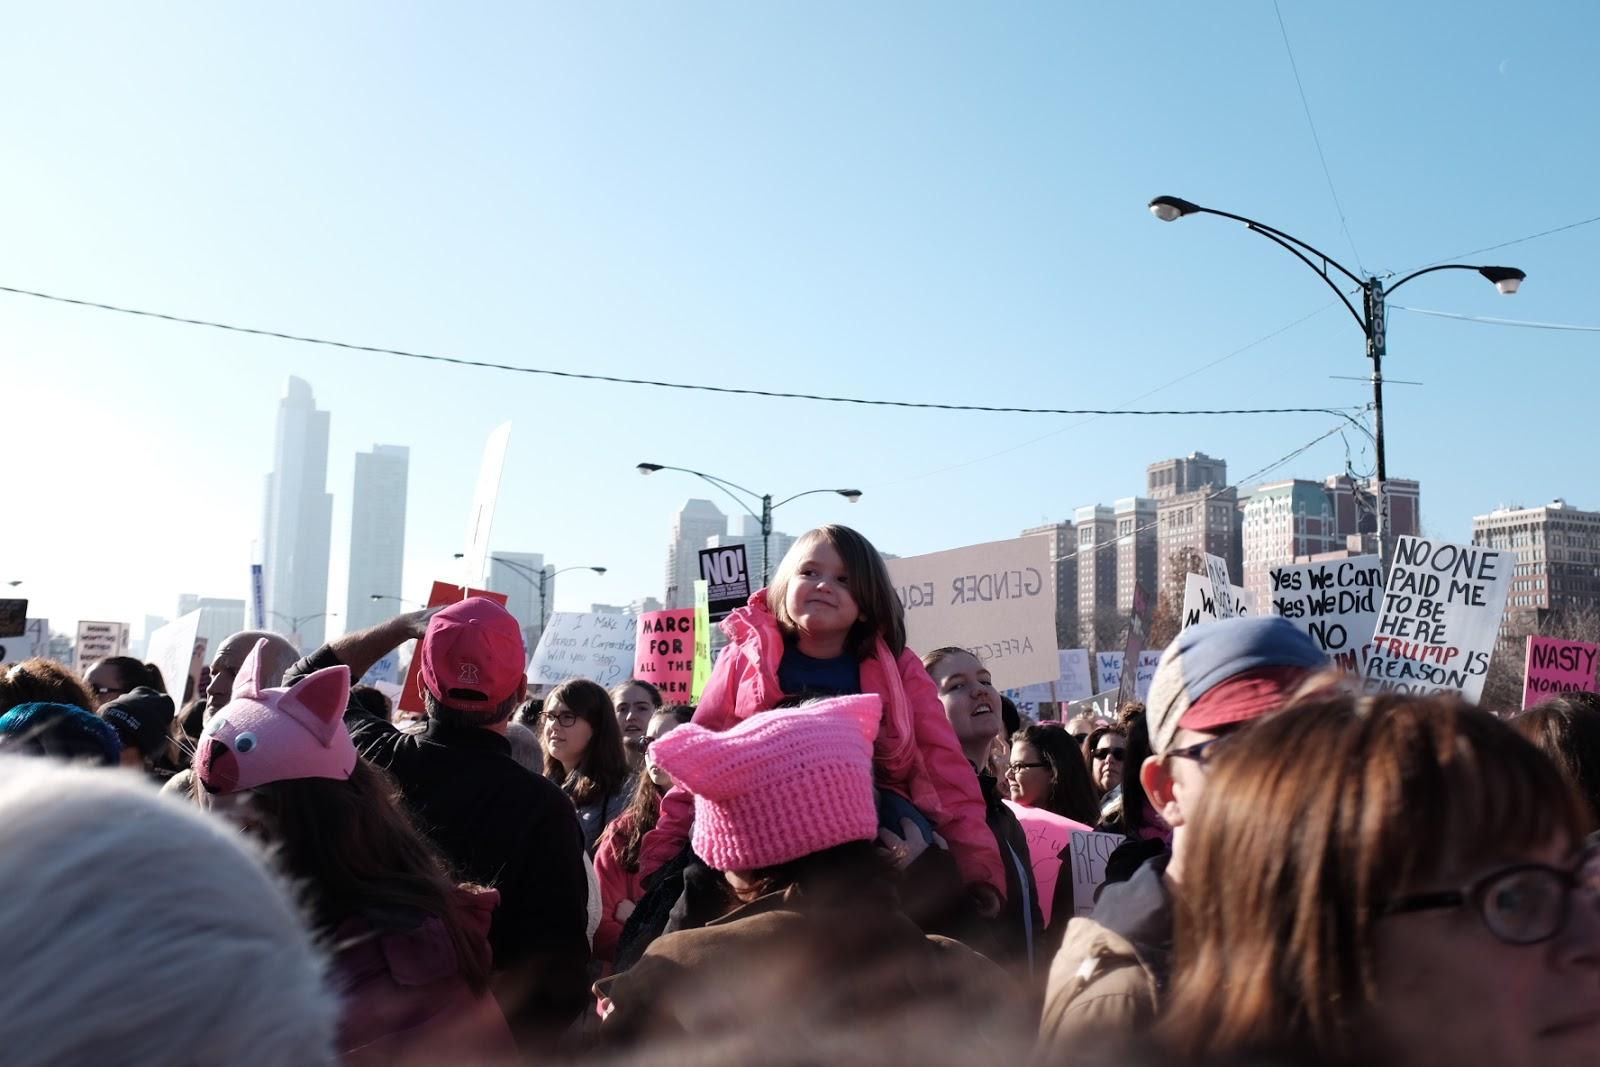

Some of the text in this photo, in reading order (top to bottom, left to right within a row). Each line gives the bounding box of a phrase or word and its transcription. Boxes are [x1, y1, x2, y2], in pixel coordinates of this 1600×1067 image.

[702, 549, 746, 586] NO!
[1396, 538, 1499, 581] NO ONE
[1269, 563, 1382, 591] Yes We Can
[1389, 567, 1486, 606] PAID ME
[1273, 598, 1305, 618] Yes
[1307, 590, 1336, 616] We
[1339, 588, 1376, 615] Did
[1385, 594, 1445, 623] TO BE
[1308, 620, 1347, 650] NO
[1380, 615, 1447, 644] HERE
[650, 639, 682, 656] FOR
[1374, 636, 1459, 665] TRUMP
[1463, 650, 1489, 675] IS
[1533, 644, 1597, 674] NASTY
[640, 661, 692, 672] ALL THE
[1366, 657, 1467, 688] REASON
[652, 682, 687, 692] MEN
